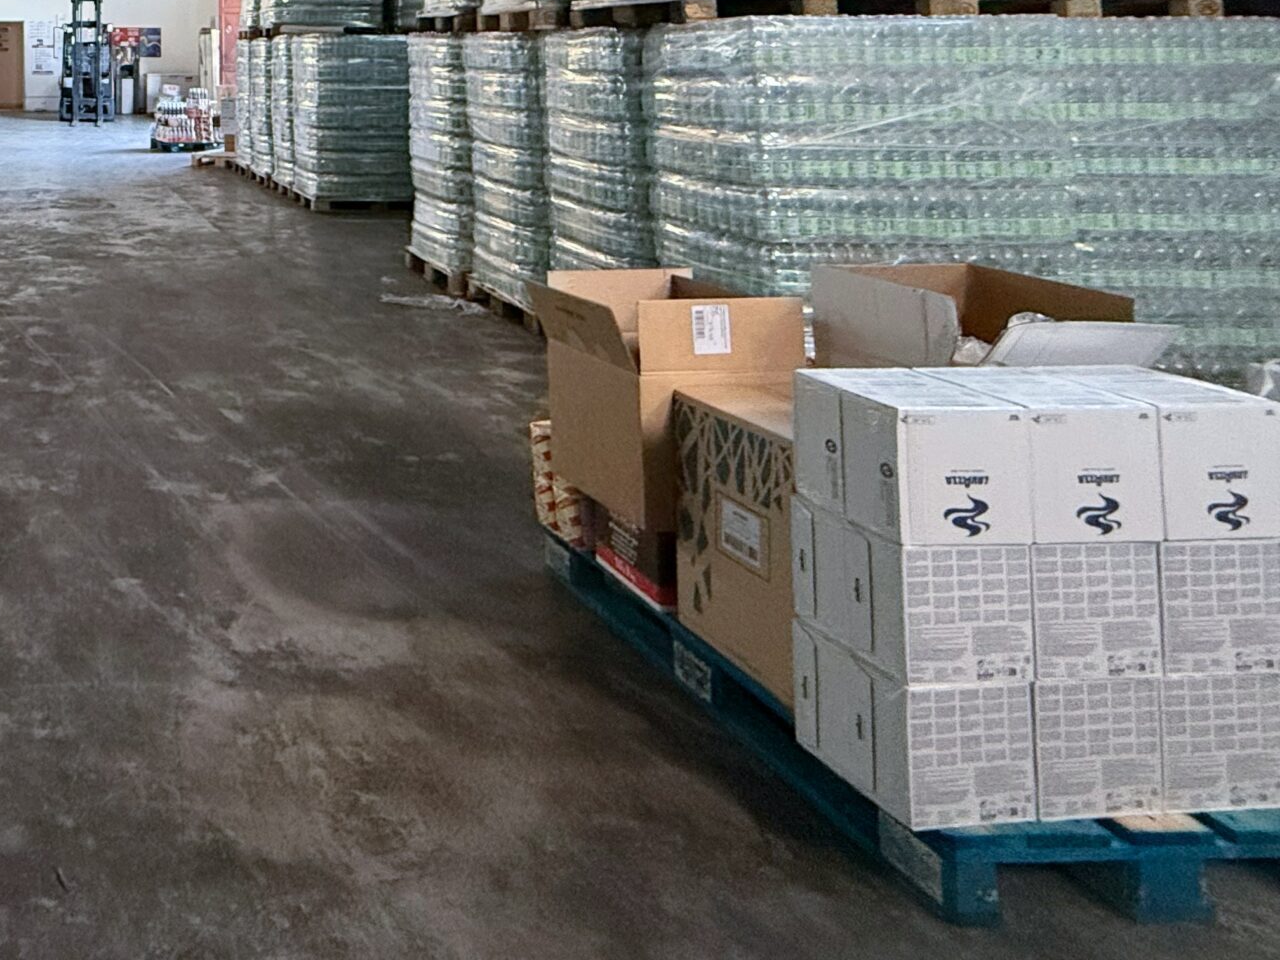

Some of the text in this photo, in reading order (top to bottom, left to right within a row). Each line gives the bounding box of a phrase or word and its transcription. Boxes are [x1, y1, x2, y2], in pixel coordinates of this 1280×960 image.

[945, 476, 989, 488] LAVAZZA
[1077, 474, 1120, 487] LAVAZZA
[1207, 470, 1249, 483] LAVAZZA
